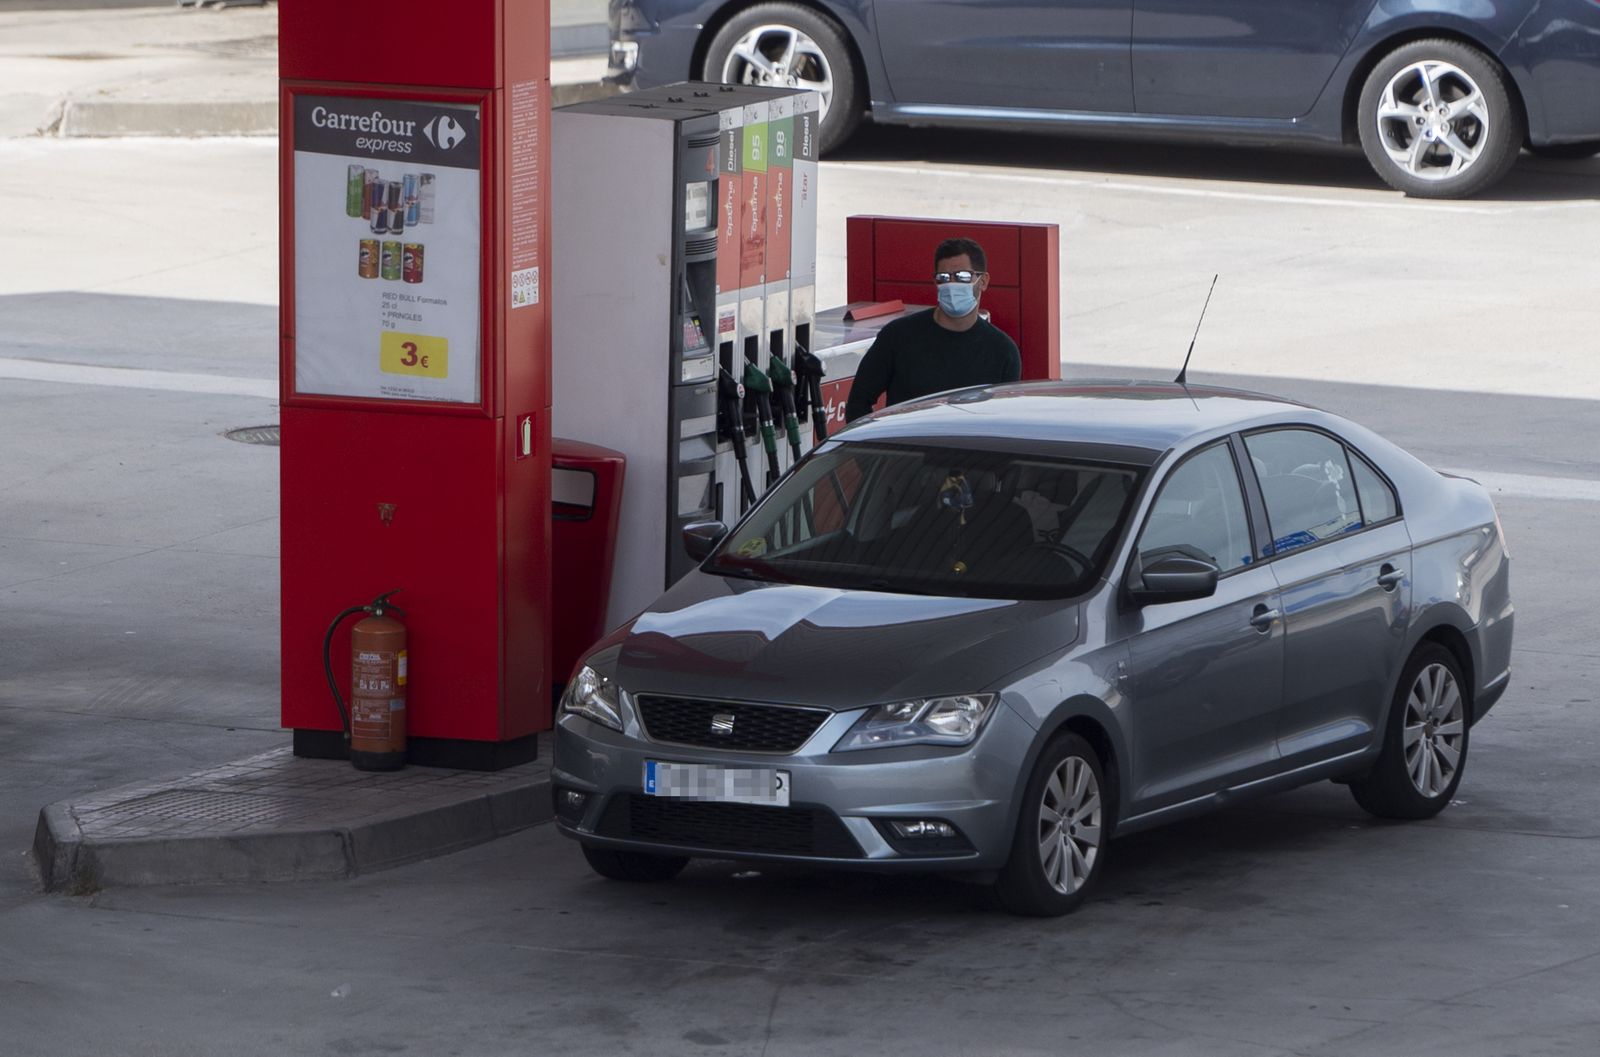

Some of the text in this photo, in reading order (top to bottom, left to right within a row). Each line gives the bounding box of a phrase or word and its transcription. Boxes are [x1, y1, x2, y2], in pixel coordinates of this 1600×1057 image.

[311, 106, 416, 137] Carrefour
[355, 136, 412, 154] express
[727, 130, 735, 171] Diesel
[752, 135, 761, 161] 95
[776, 131, 785, 157] 98
[382, 292, 398, 301] RED
[398, 293, 416, 303] BULL
[382, 301, 390, 309] 25
[387, 311, 422, 322] PRINGLES
